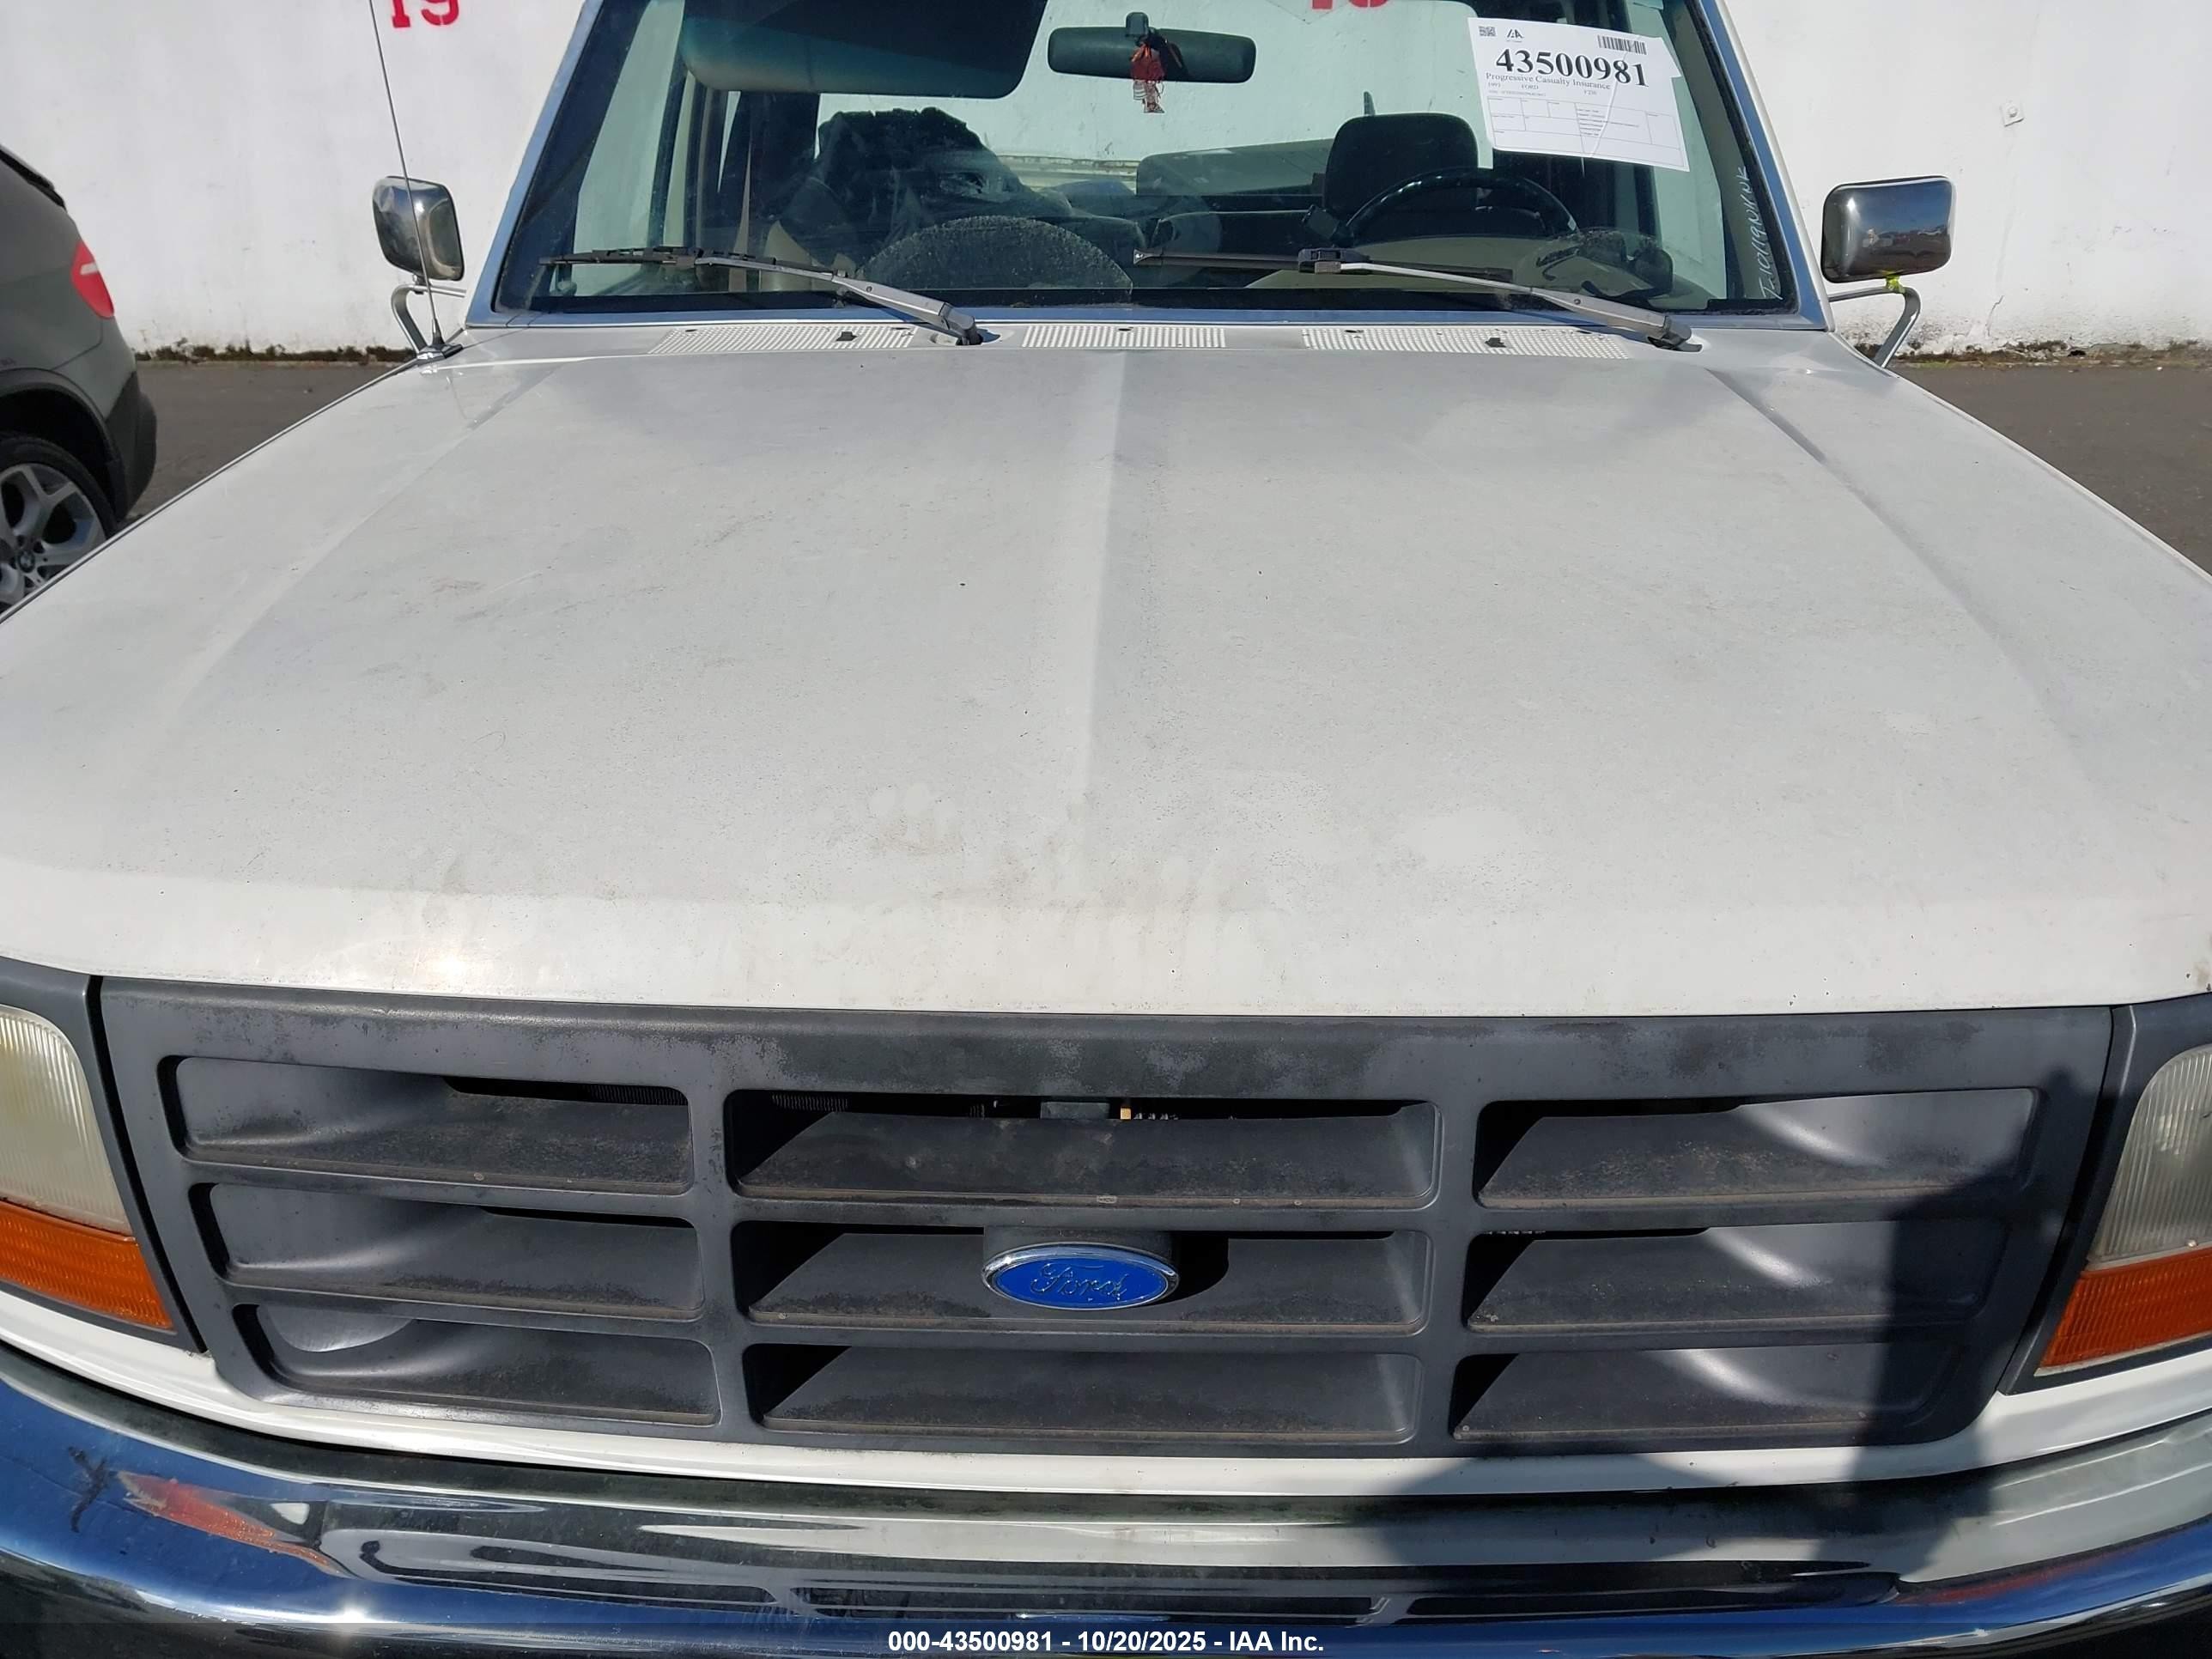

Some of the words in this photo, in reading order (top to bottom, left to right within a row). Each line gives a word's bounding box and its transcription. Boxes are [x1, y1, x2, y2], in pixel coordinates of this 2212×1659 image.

[1486, 72, 1534, 83] Progressive
[1535, 75, 1571, 87] Casualty
[1573, 78, 1611, 90] Insurance
[1496, 48, 1650, 88] 43500981
[1030, 1261, 1129, 1300] Ford
